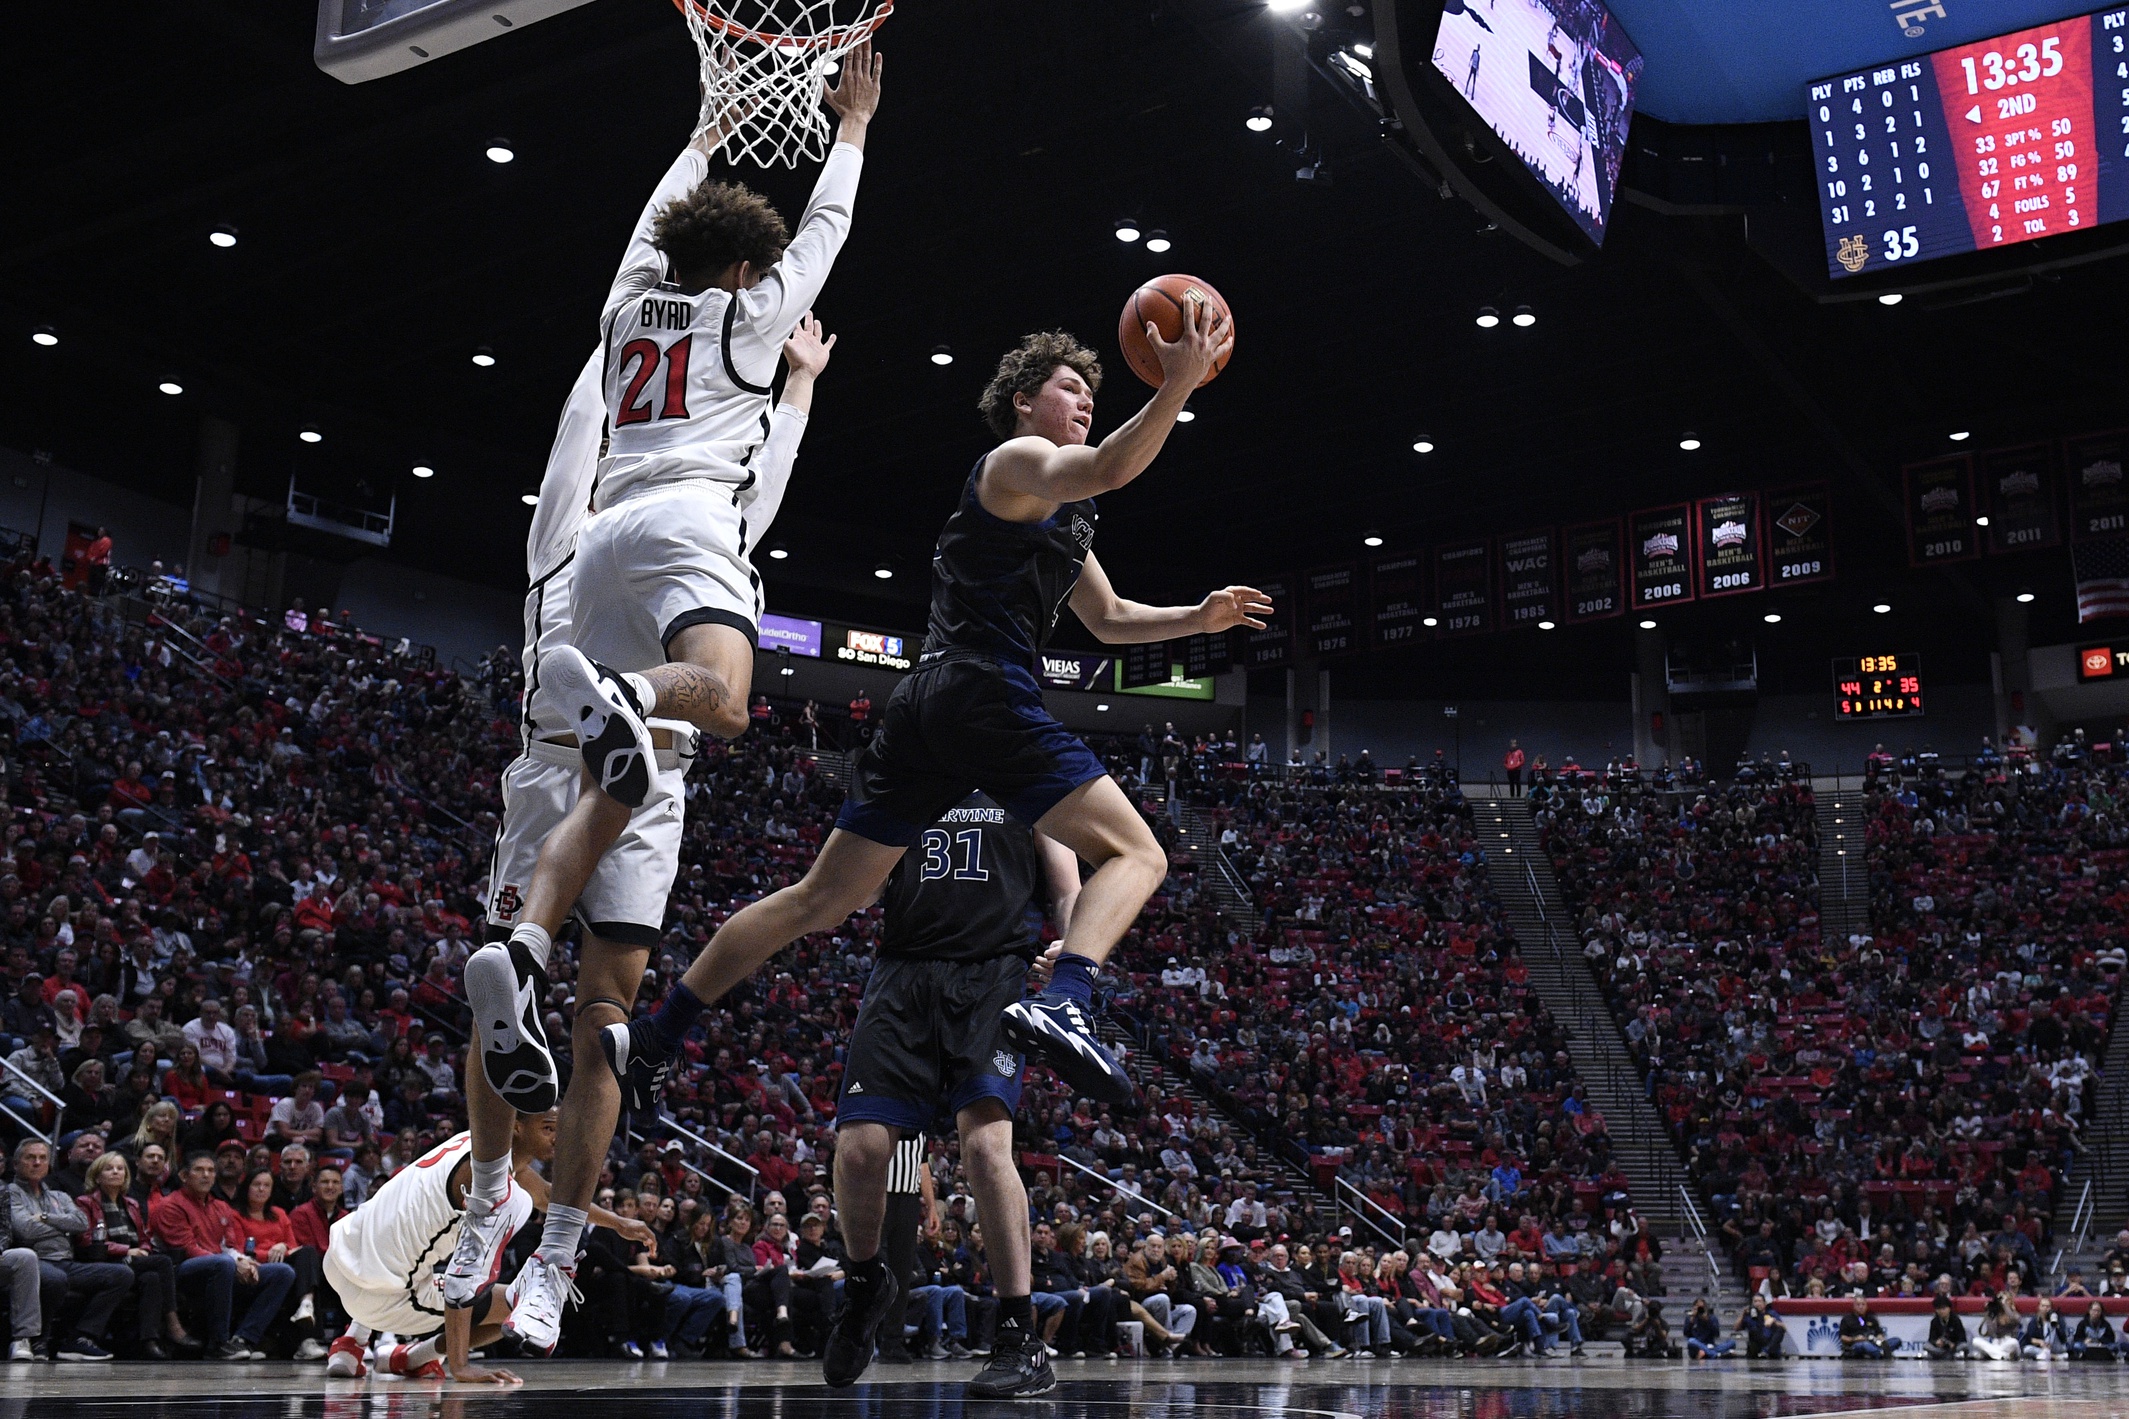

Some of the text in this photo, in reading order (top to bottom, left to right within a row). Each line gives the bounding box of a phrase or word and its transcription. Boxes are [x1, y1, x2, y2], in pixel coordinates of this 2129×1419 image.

[2103, 11, 2126, 30] PLY
[2113, 35, 2124, 53] 3
[1961, 36, 2063, 95] 13:35
[2117, 61, 2128, 79] 4
[1812, 62, 1921, 101] PLY PTS REB FLS
[1819, 85, 1919, 122] 0 4 0 1
[1997, 93, 2037, 119] 2ND
[1825, 111, 1922, 147] 1 3 2 1
[1975, 117, 2072, 154] 33 3PT % 50
[1827, 136, 1926, 172] 3 6 1 2
[1978, 140, 2075, 176] 32 FG % 50
[1828, 163, 1929, 198] 10 2 1 0
[1981, 163, 2077, 199] 67 FT % 89
[1832, 188, 1933, 224] 31 2 2 1
[1989, 187, 2076, 220] 4 FOULS 5
[1991, 209, 2079, 242] 2 TOL 3
[1883, 225, 1919, 261] 35
[641, 299, 691, 331] BYRD
[615, 332, 693, 429] 21
[2089, 514, 2124, 532] 2011
[2007, 527, 2041, 545] 2011
[1925, 539, 1962, 557] 2010
[1506, 555, 1548, 573] WAC
[1782, 560, 1820, 578] 2009
[1713, 572, 1750, 589] 2006
[1644, 583, 1682, 600] 2006
[1514, 604, 1546, 620] 1985
[1578, 597, 1612, 614] 2002
[1448, 615, 1480, 630] 1978
[758, 627, 807, 642] uidelOrtho
[1383, 625, 1413, 641] 1977
[851, 632, 898, 655] FOX 5
[1317, 636, 1347, 651] 1976
[857, 650, 877, 663] San
[879, 654, 910, 668] Diego
[1042, 656, 1080, 675] VIEJAS
[1861, 655, 1897, 672] 13:35
[1841, 676, 1919, 696] 44 2 35
[1841, 700, 1851, 714] 5
[1911, 696, 1920, 708] 4
[920, 828, 989, 883] 31
